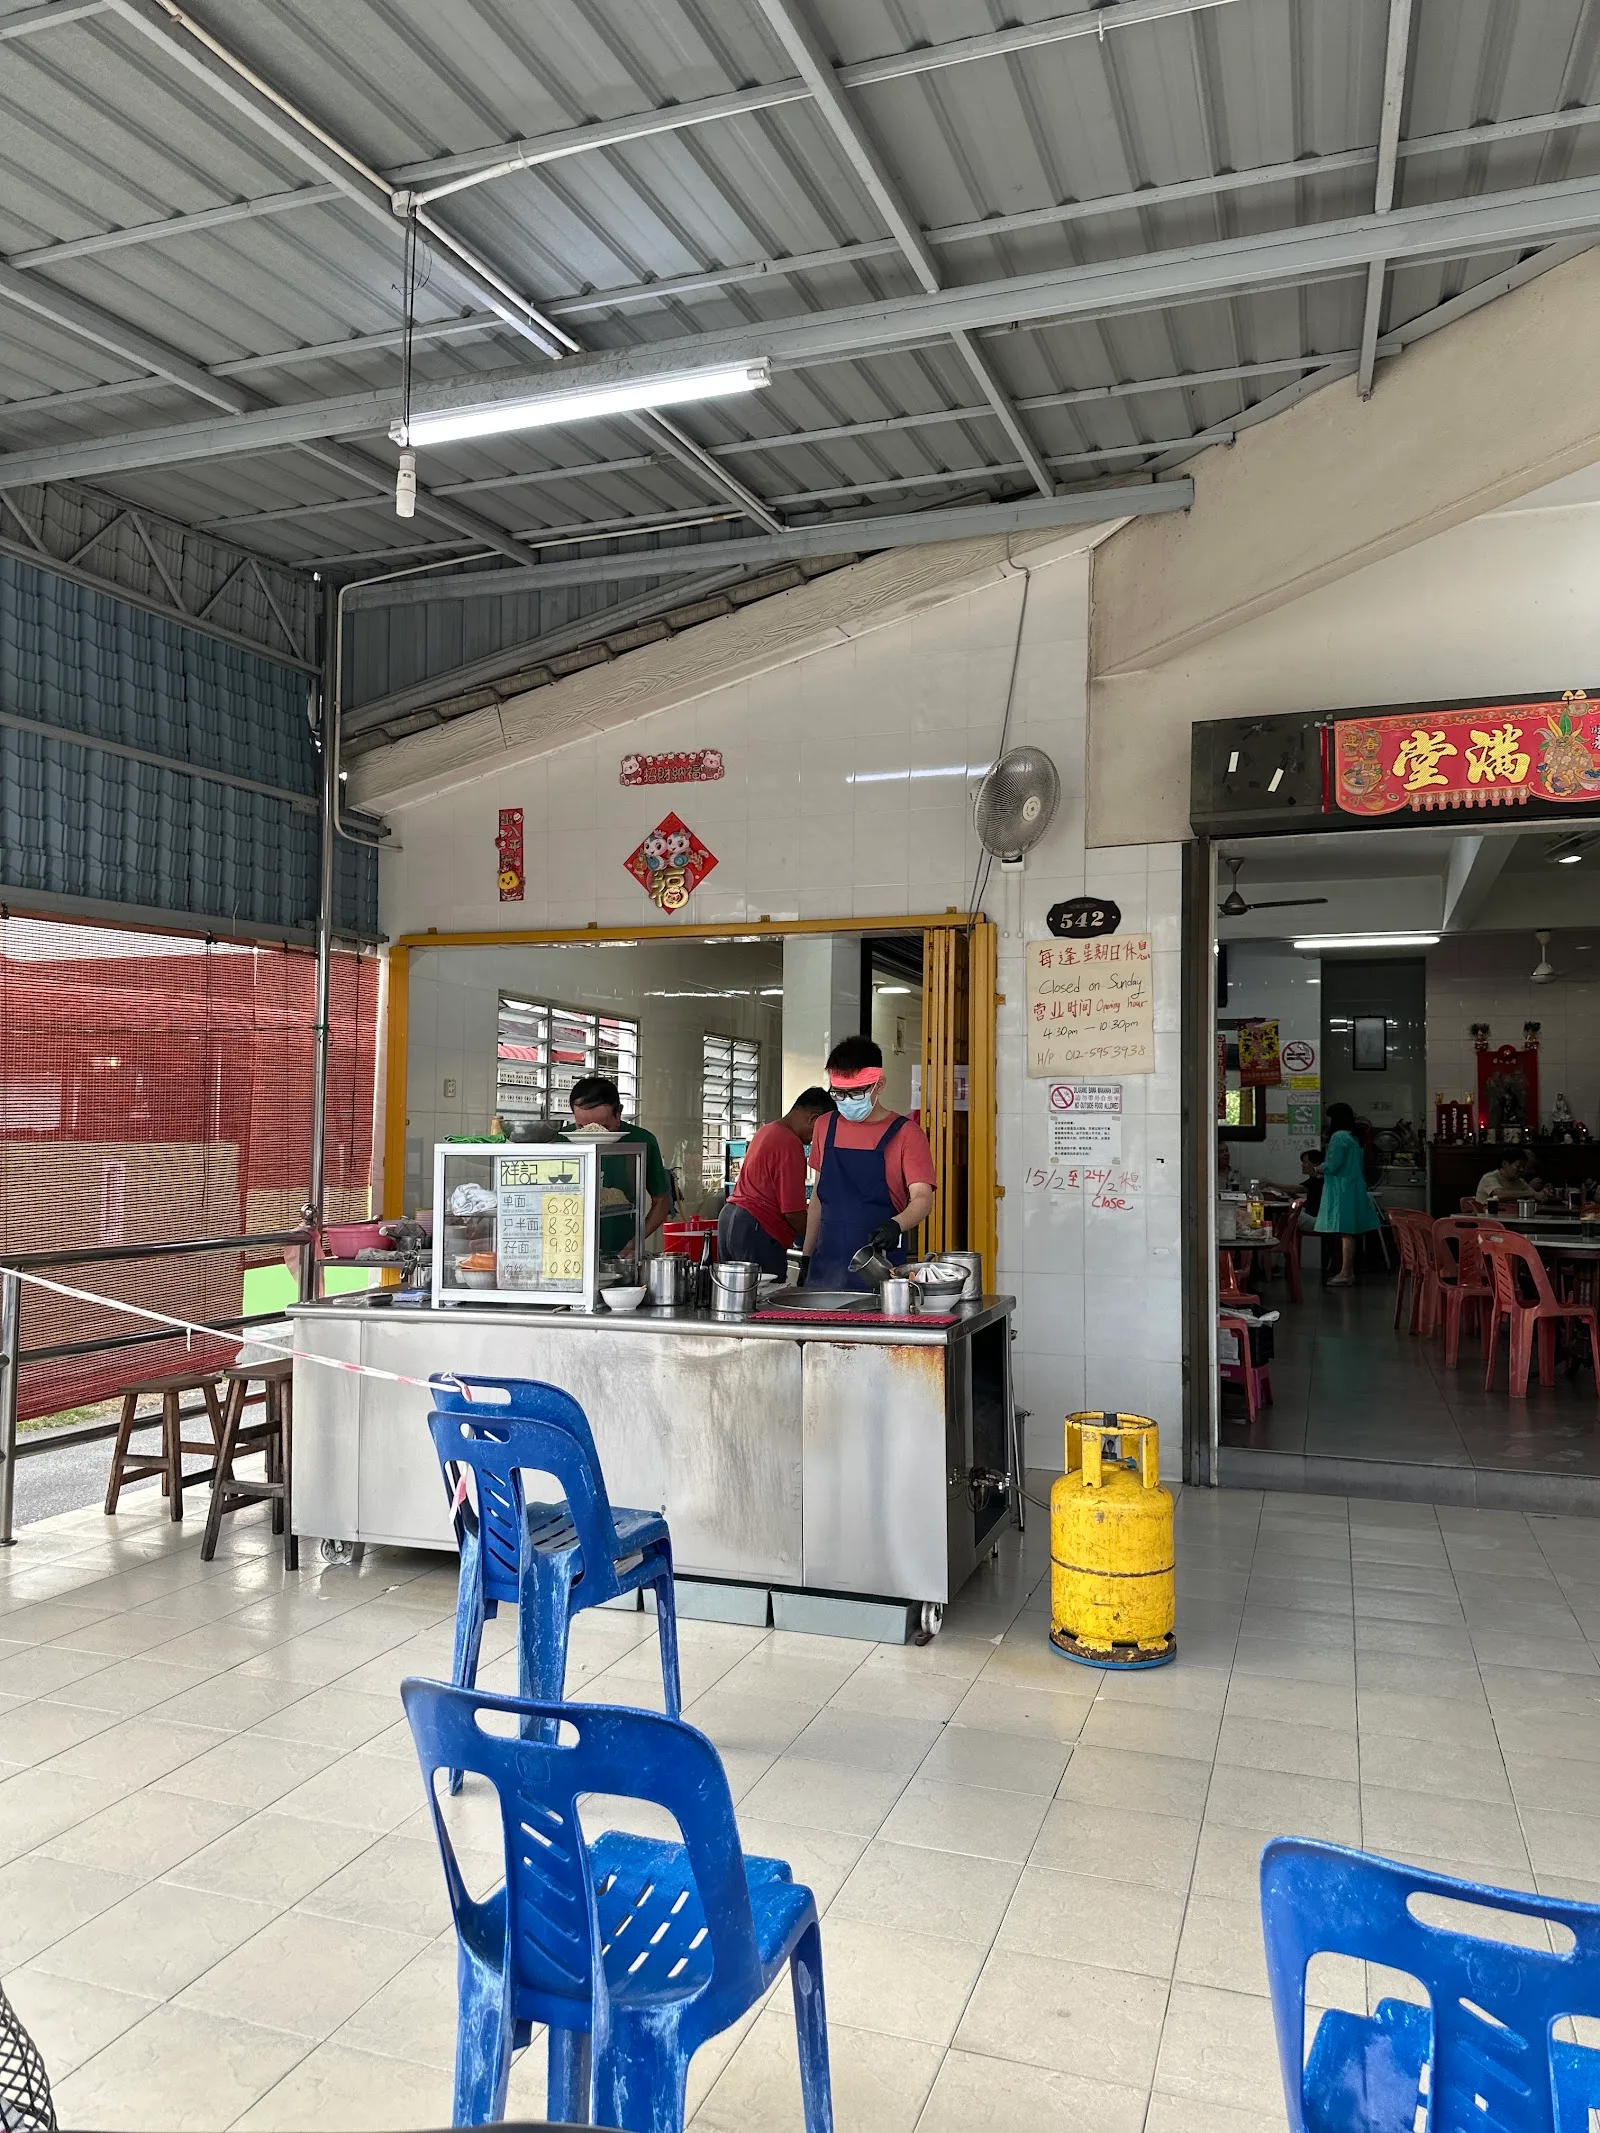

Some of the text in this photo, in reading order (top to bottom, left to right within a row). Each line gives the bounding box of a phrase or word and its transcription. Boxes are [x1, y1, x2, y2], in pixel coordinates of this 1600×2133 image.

[648, 867, 690, 909] 福
[1060, 910, 1105, 929] 542
[1039, 939, 1151, 969] 每逢星期日休息
[1038, 972, 1145, 999] Closed on Sunday
[1033, 999, 1092, 1022] 营业时间
[1043, 1026, 1078, 1039] 4:30pm
[1065, 1044, 1146, 1062] 012-5953938
[501, 1160, 538, 1185] 祥記
[1025, 1167, 1066, 1191] 15/2
[1084, 1168, 1118, 1196] 24/2
[547, 1197, 579, 1215] 6.80
[1091, 1195, 1134, 1211] Close
[548, 1216, 580, 1236] 8.30
[549, 1236, 579, 1253] 9.80
